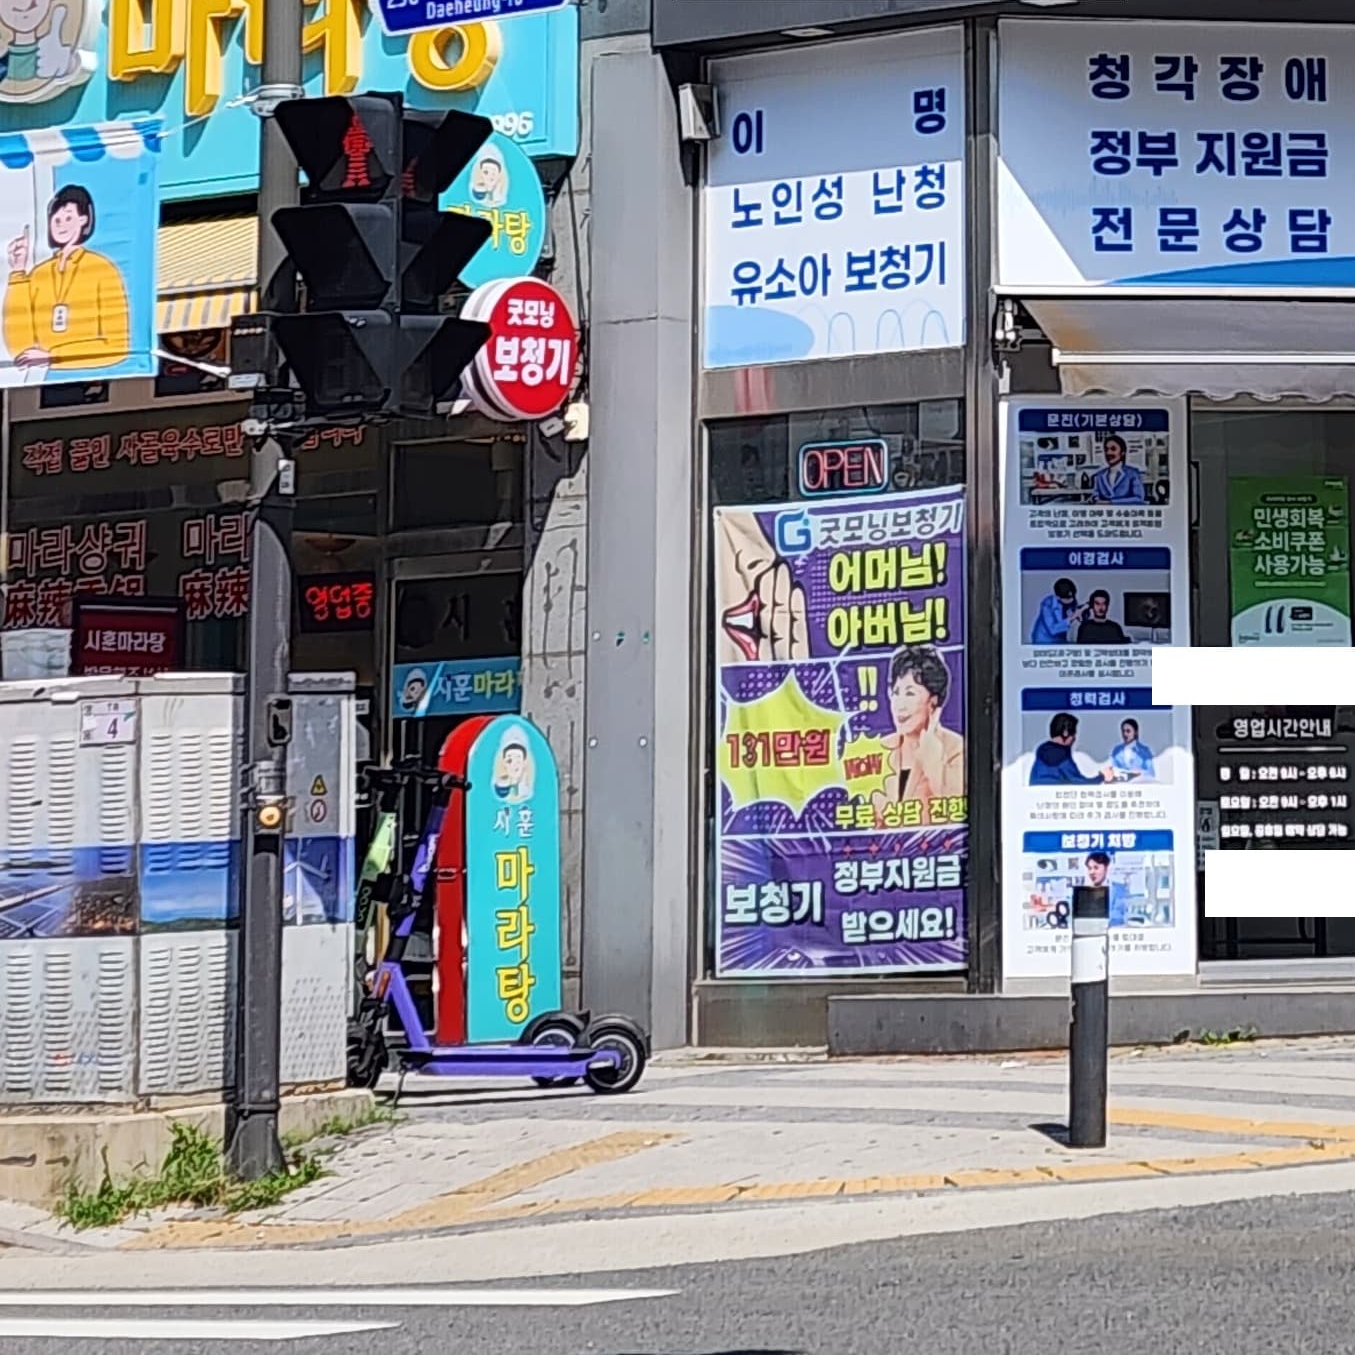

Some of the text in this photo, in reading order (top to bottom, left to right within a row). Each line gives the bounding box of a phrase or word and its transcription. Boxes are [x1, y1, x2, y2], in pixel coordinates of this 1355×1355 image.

[1090, 130, 1328, 178] 정부 지원금
[731, 163, 946, 229] 노인성 난청
[731, 242, 946, 306] 유소아 보청기
[508, 298, 554, 328] 굿모닝
[494, 335, 570, 386] 보청기
[803, 446, 885, 490] OPEN
[819, 502, 962, 547] 굿모닝보청기
[1253, 507, 1325, 530] 민생회복
[1253, 530, 1325, 553] 소비쿠폰
[829, 542, 947, 593] 어머님!
[1254, 554, 1326, 577] 사용가능
[305, 582, 373, 621] 영업중
[826, 597, 948, 648] 아버님!
[433, 669, 522, 703] 시훈마라
[107, 717, 119, 740] 4
[1233, 718, 1332, 738] 영업시간안내
[492, 805, 535, 838] 시훈
[834, 854, 962, 894] 정부지원금
[724, 882, 823, 924] 보청기
[494, 845, 535, 1025] 마라탕
[842, 907, 954, 944] 받으세요!
